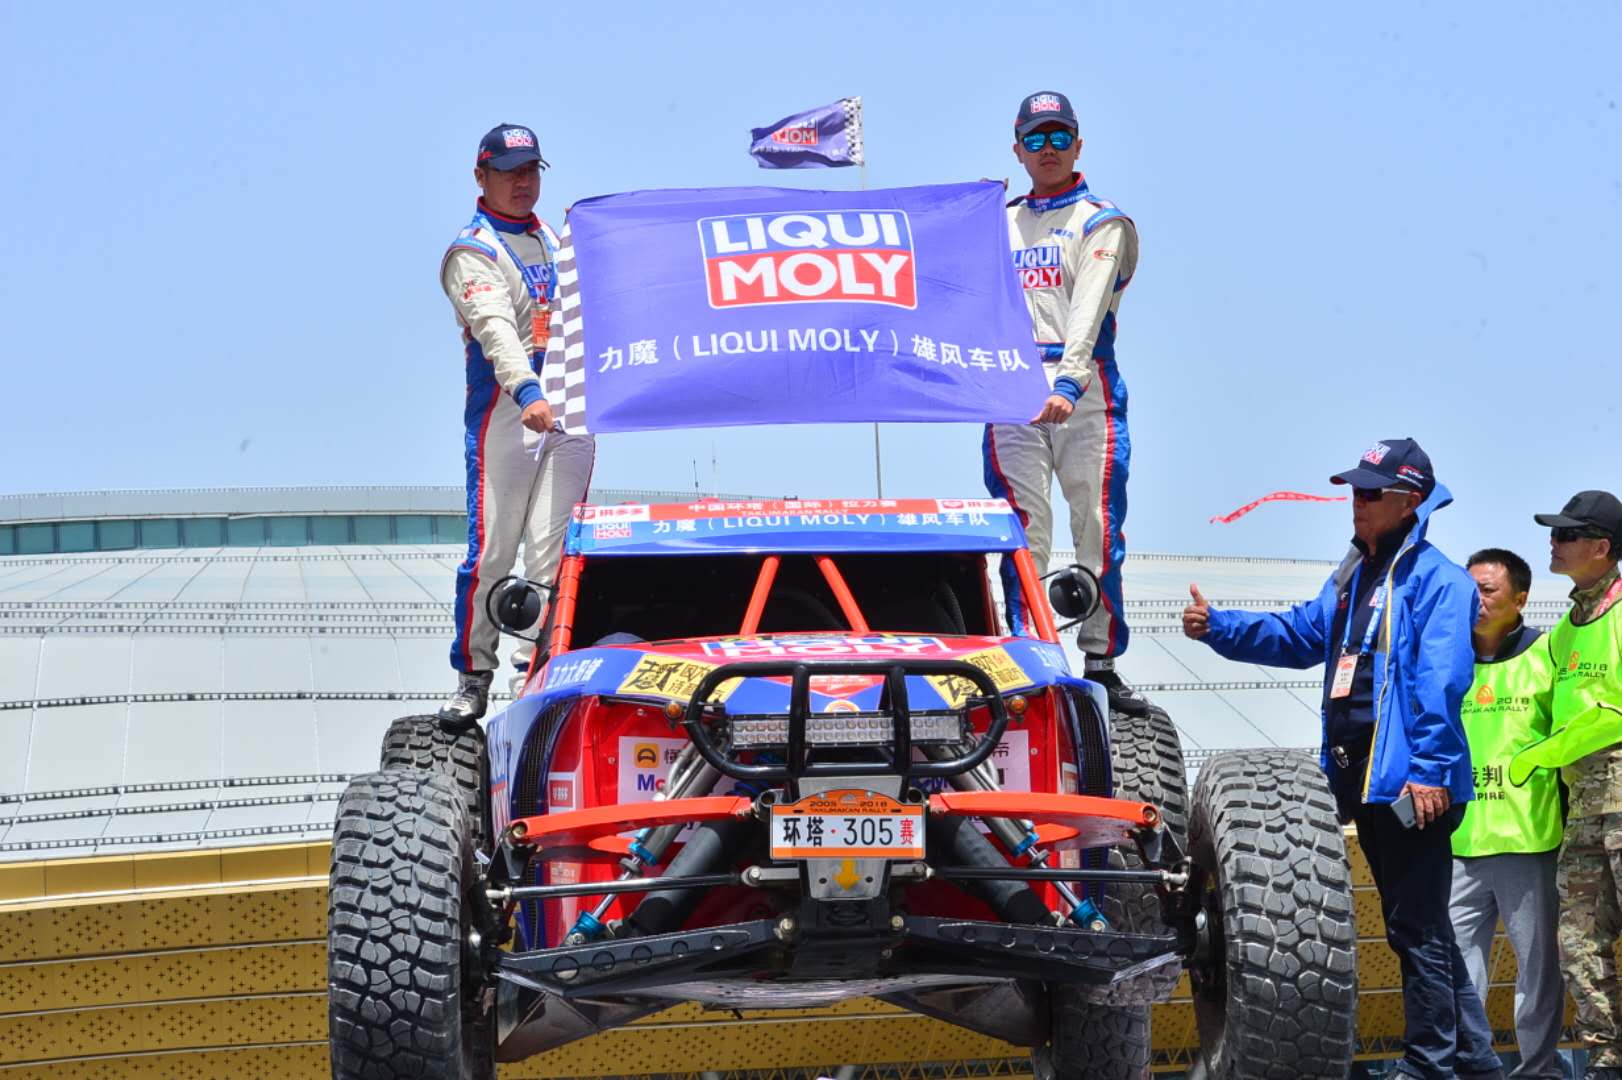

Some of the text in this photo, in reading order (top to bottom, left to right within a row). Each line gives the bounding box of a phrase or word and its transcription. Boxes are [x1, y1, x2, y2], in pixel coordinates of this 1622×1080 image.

[716, 213, 900, 252] LIQUI
[719, 251, 909, 301] MOLY
[721, 645, 937, 657] MOLY
[1496, 697, 1530, 705] 2018
[859, 800, 888, 808] 2018
